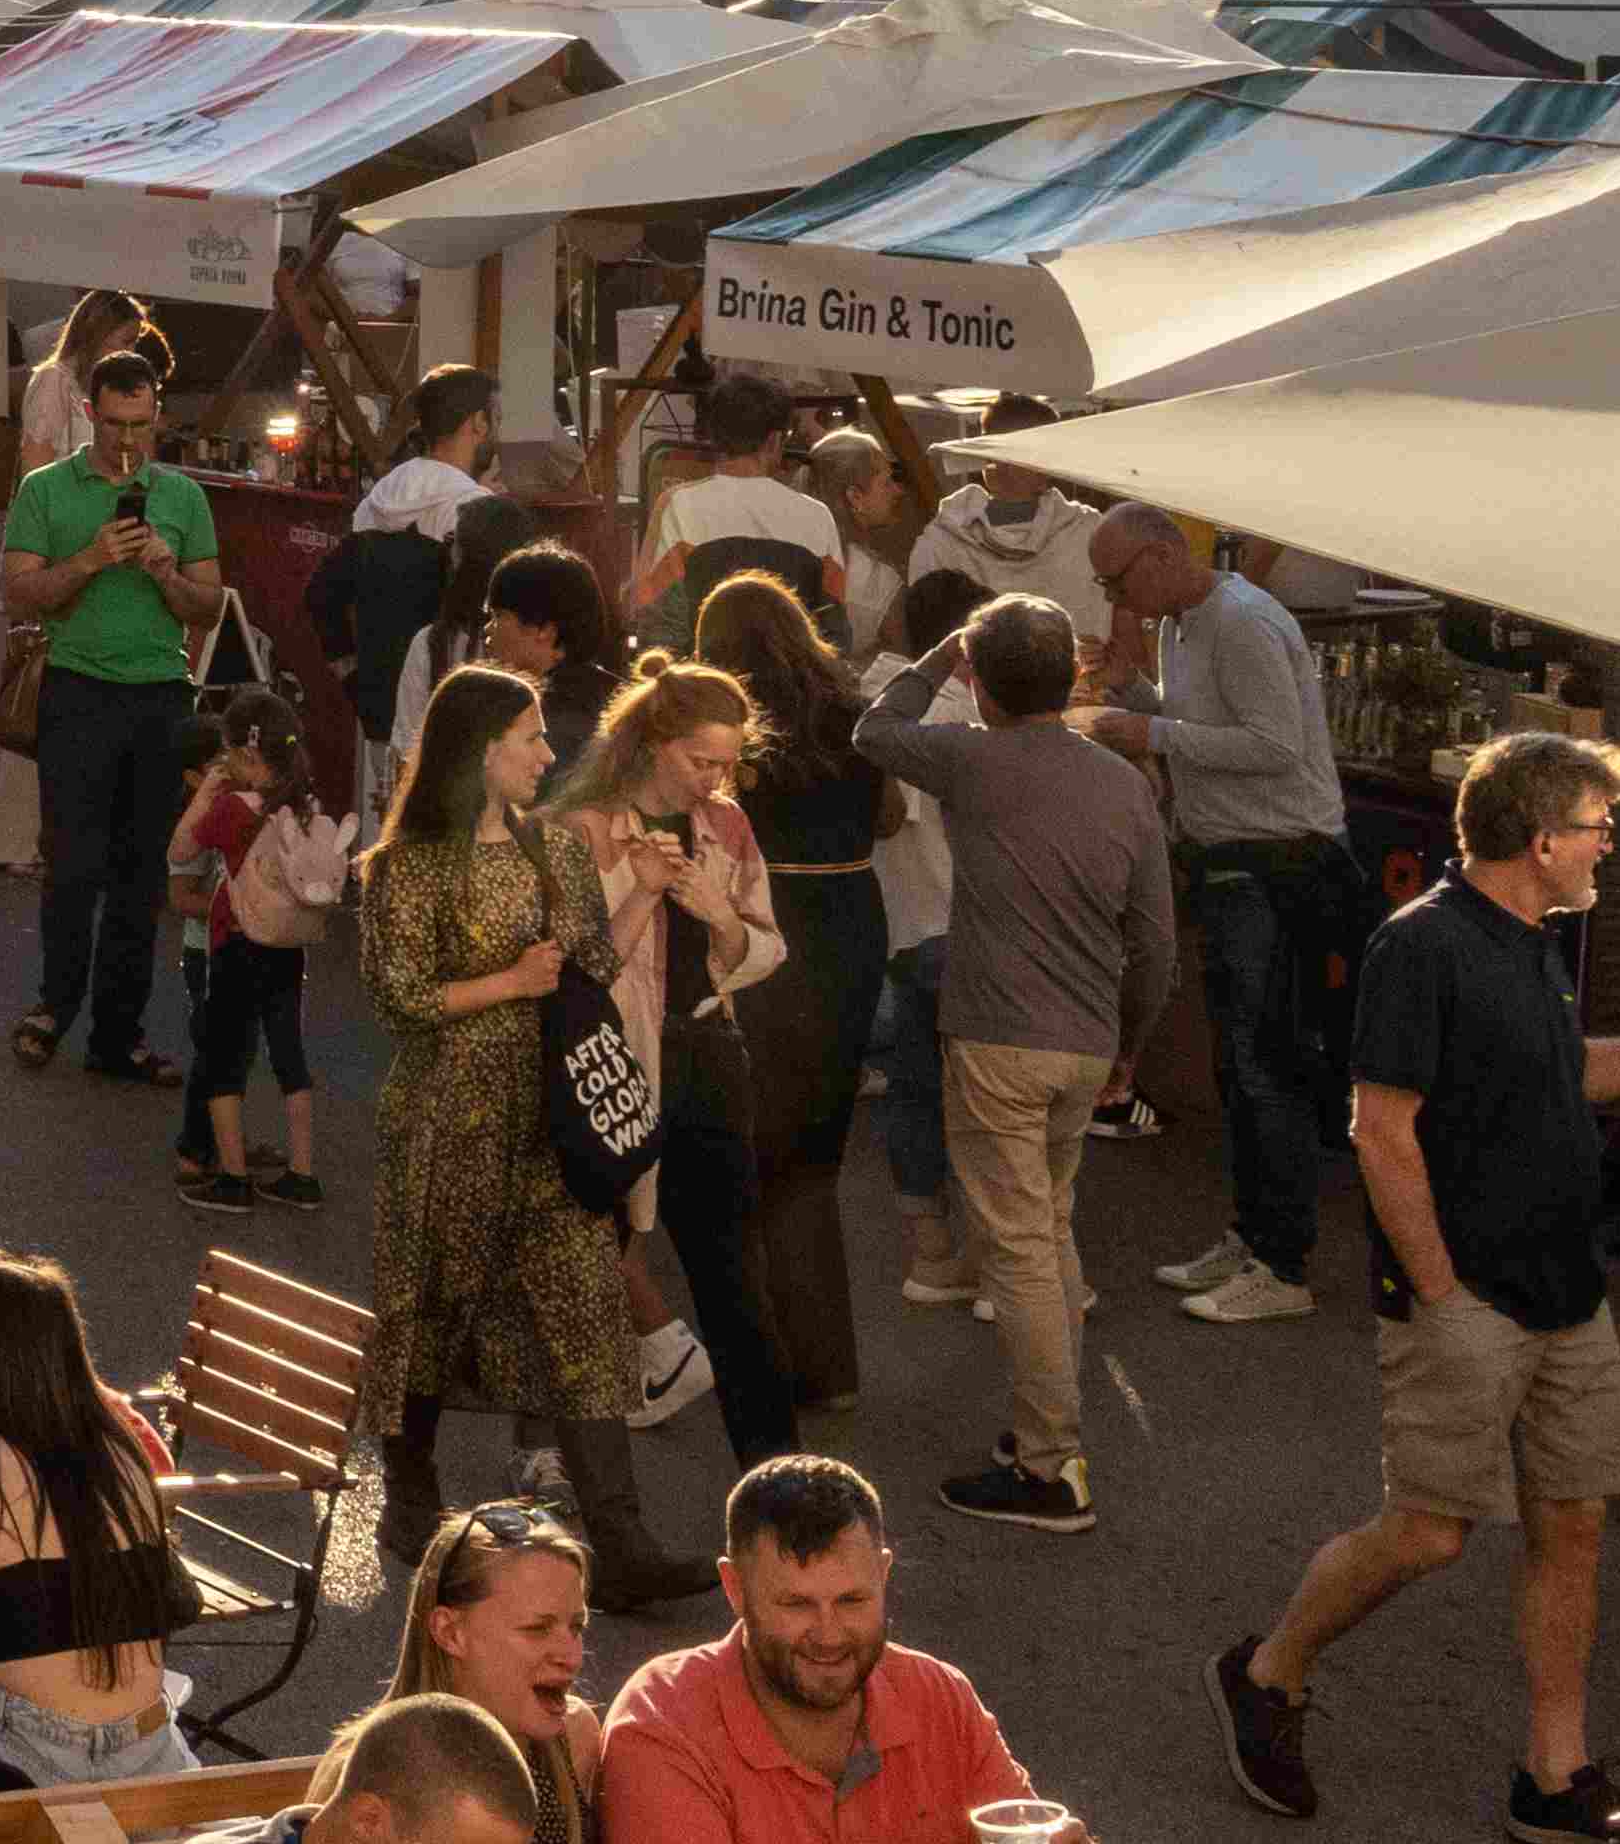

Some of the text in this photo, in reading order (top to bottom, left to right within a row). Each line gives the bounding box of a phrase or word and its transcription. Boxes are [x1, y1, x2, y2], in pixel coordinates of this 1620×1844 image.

[717, 277, 1015, 351] Brina Gin & Tonic
[564, 1021, 621, 1079] AFTER
[574, 1054, 629, 1106] COLD
